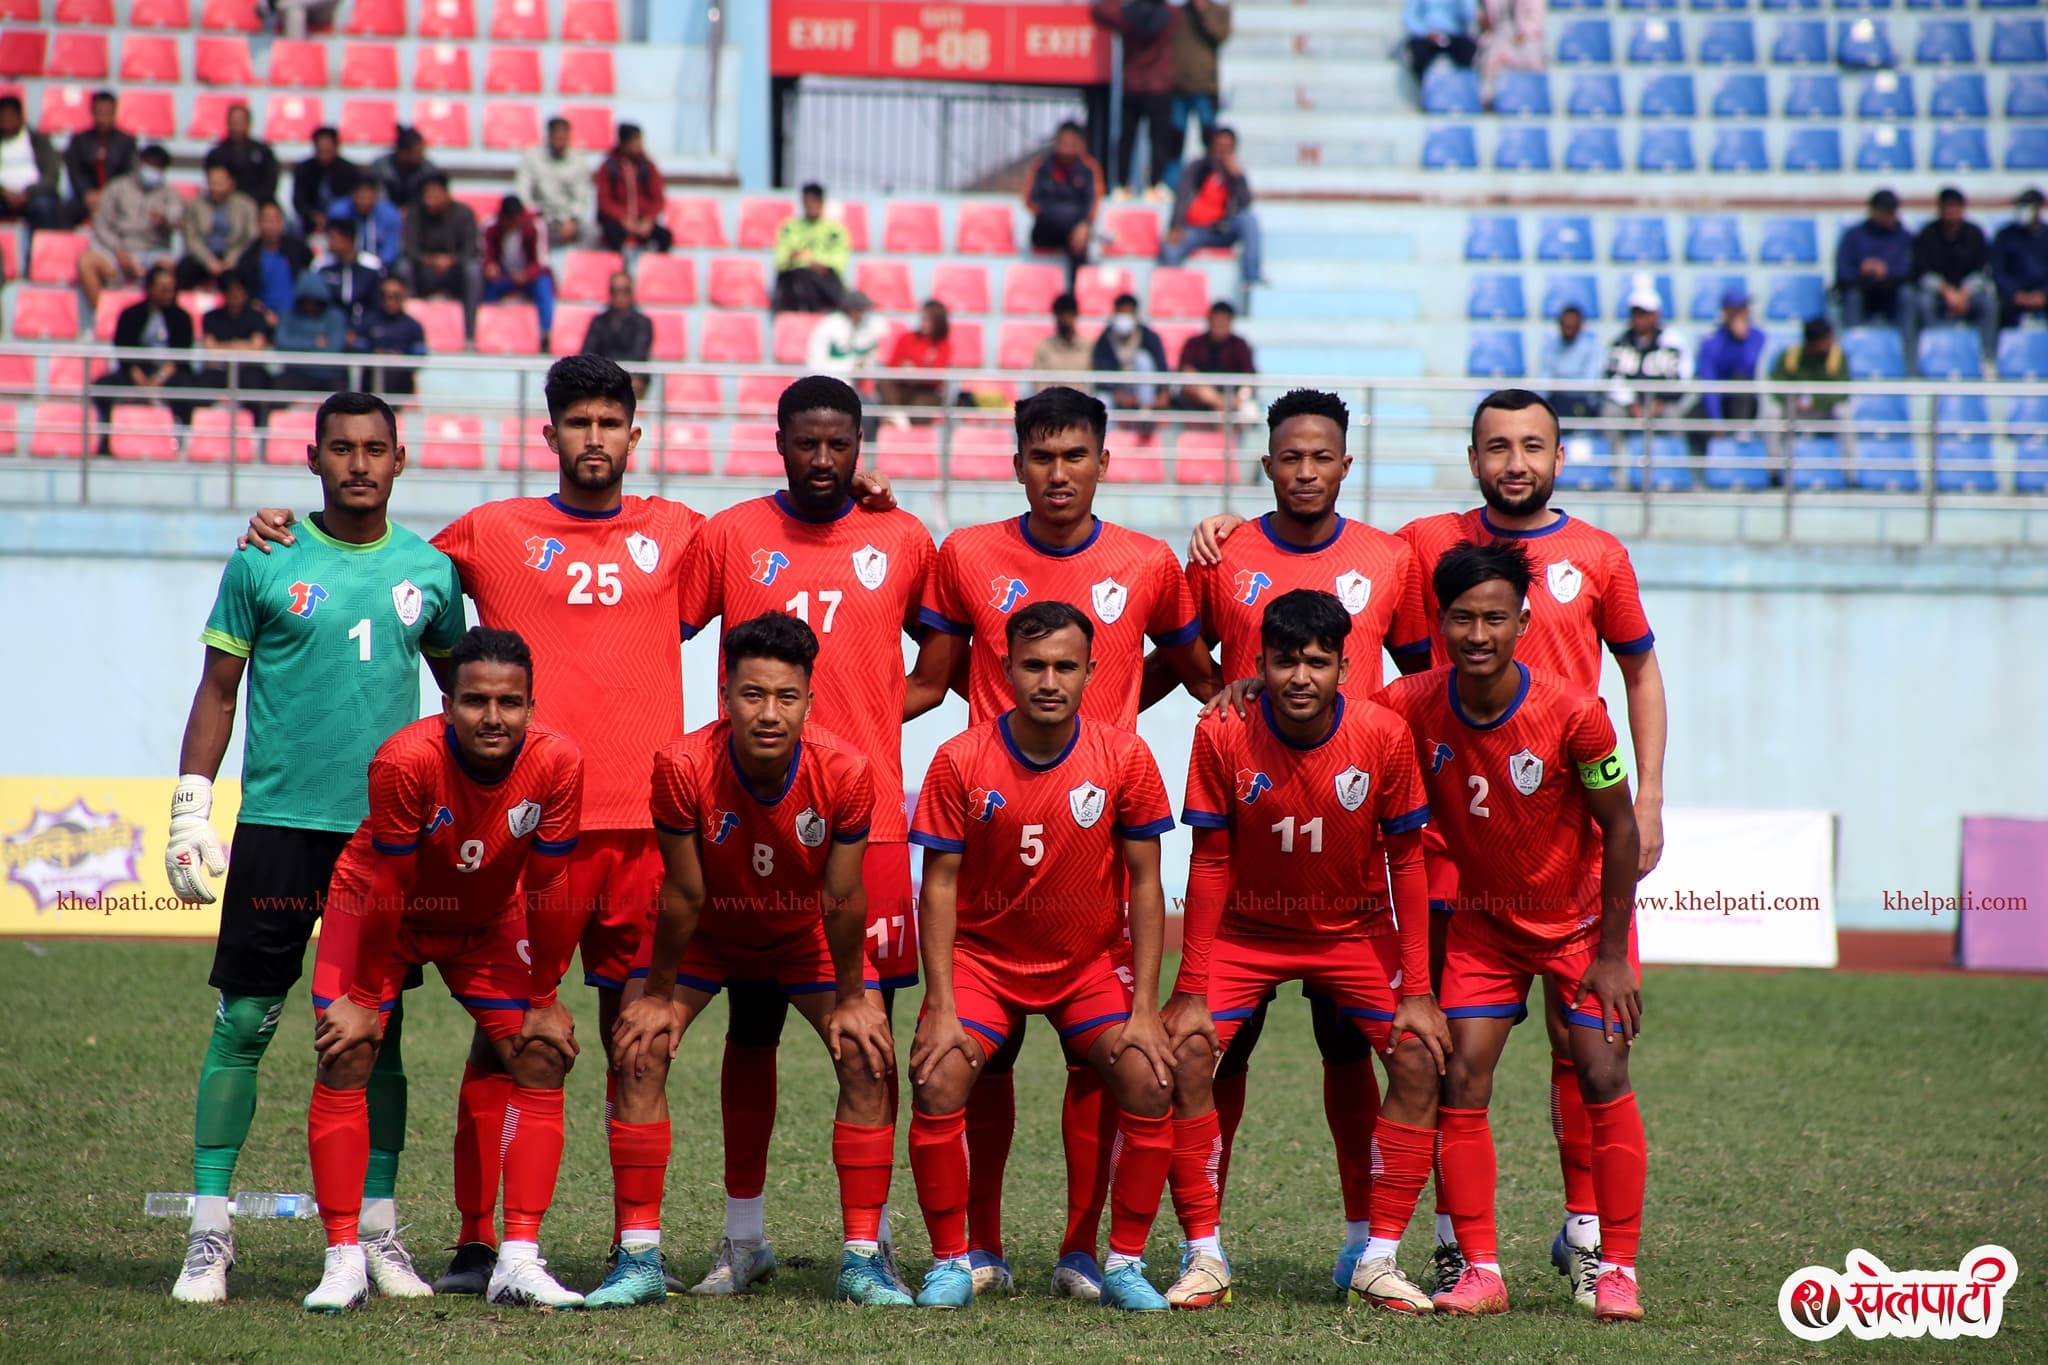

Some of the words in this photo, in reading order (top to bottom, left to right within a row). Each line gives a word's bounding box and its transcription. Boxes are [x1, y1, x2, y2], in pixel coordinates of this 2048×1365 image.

[788, 18, 856, 49] EXIT
[1026, 25, 1096, 57] EXIT
[566, 561, 623, 606] 25
[785, 590, 843, 634] 17
[348, 619, 371, 661] 1
[1600, 755, 1621, 781] C
[1468, 775, 1489, 818] 2
[1020, 824, 1044, 867] 5
[1271, 816, 1323, 853] 11
[456, 839, 484, 873] 9
[752, 843, 774, 877] 8
[865, 915, 905, 960] 17
